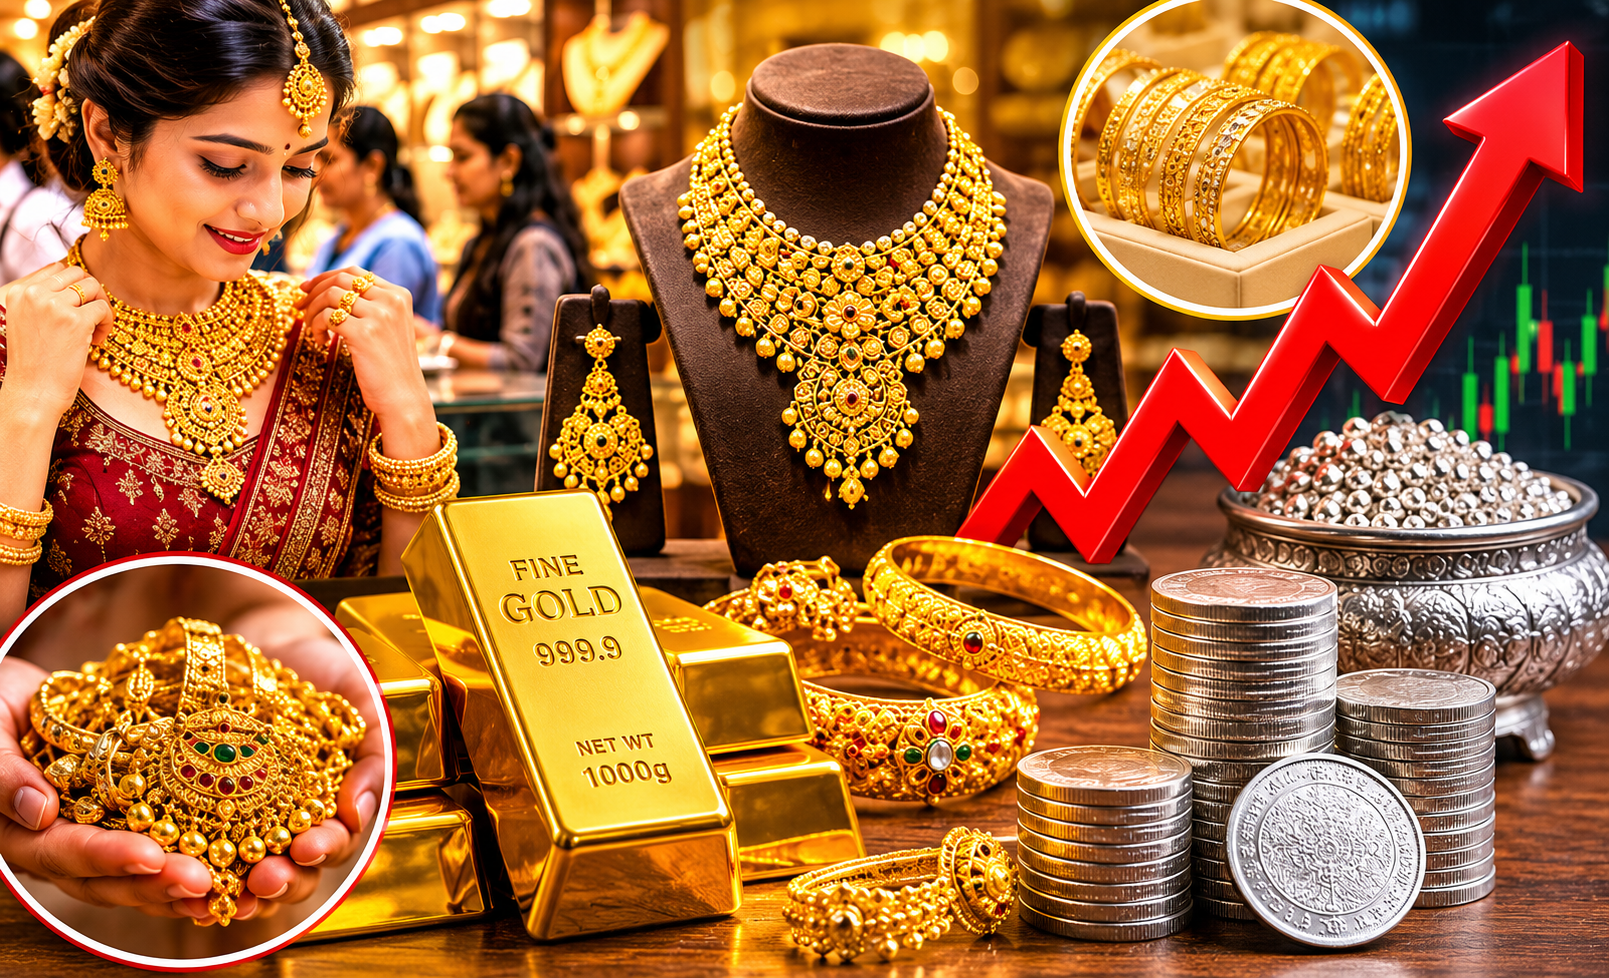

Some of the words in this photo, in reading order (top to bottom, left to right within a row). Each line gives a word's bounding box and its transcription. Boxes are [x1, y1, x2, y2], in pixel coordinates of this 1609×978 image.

[509, 554, 584, 581] FINE
[499, 585, 622, 624] GOLD
[533, 636, 622, 667] 999.9
[575, 737, 616, 757] NET
[622, 733, 654, 751] WT
[582, 760, 672, 788] 1000g
